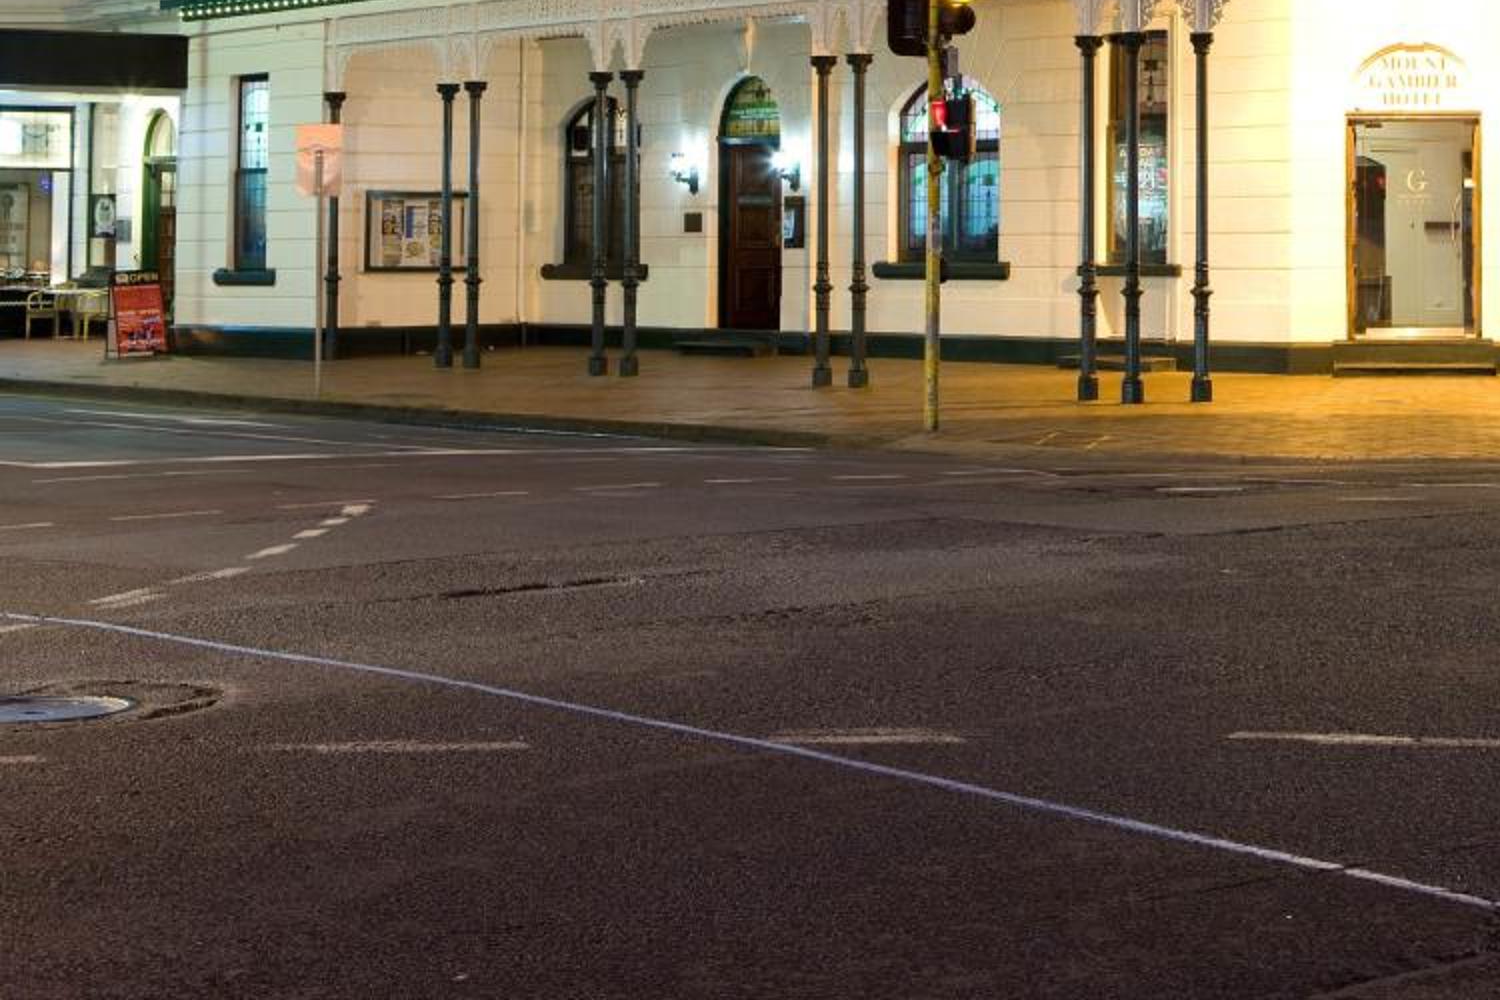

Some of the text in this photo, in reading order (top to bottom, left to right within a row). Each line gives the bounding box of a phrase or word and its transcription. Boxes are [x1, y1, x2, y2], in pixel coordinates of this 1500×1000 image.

[1381, 56, 1447, 70] MOUNT
[1381, 92, 1441, 105] HOTEL
[1406, 168, 1429, 193] G
[129, 271, 159, 283] OPEN
